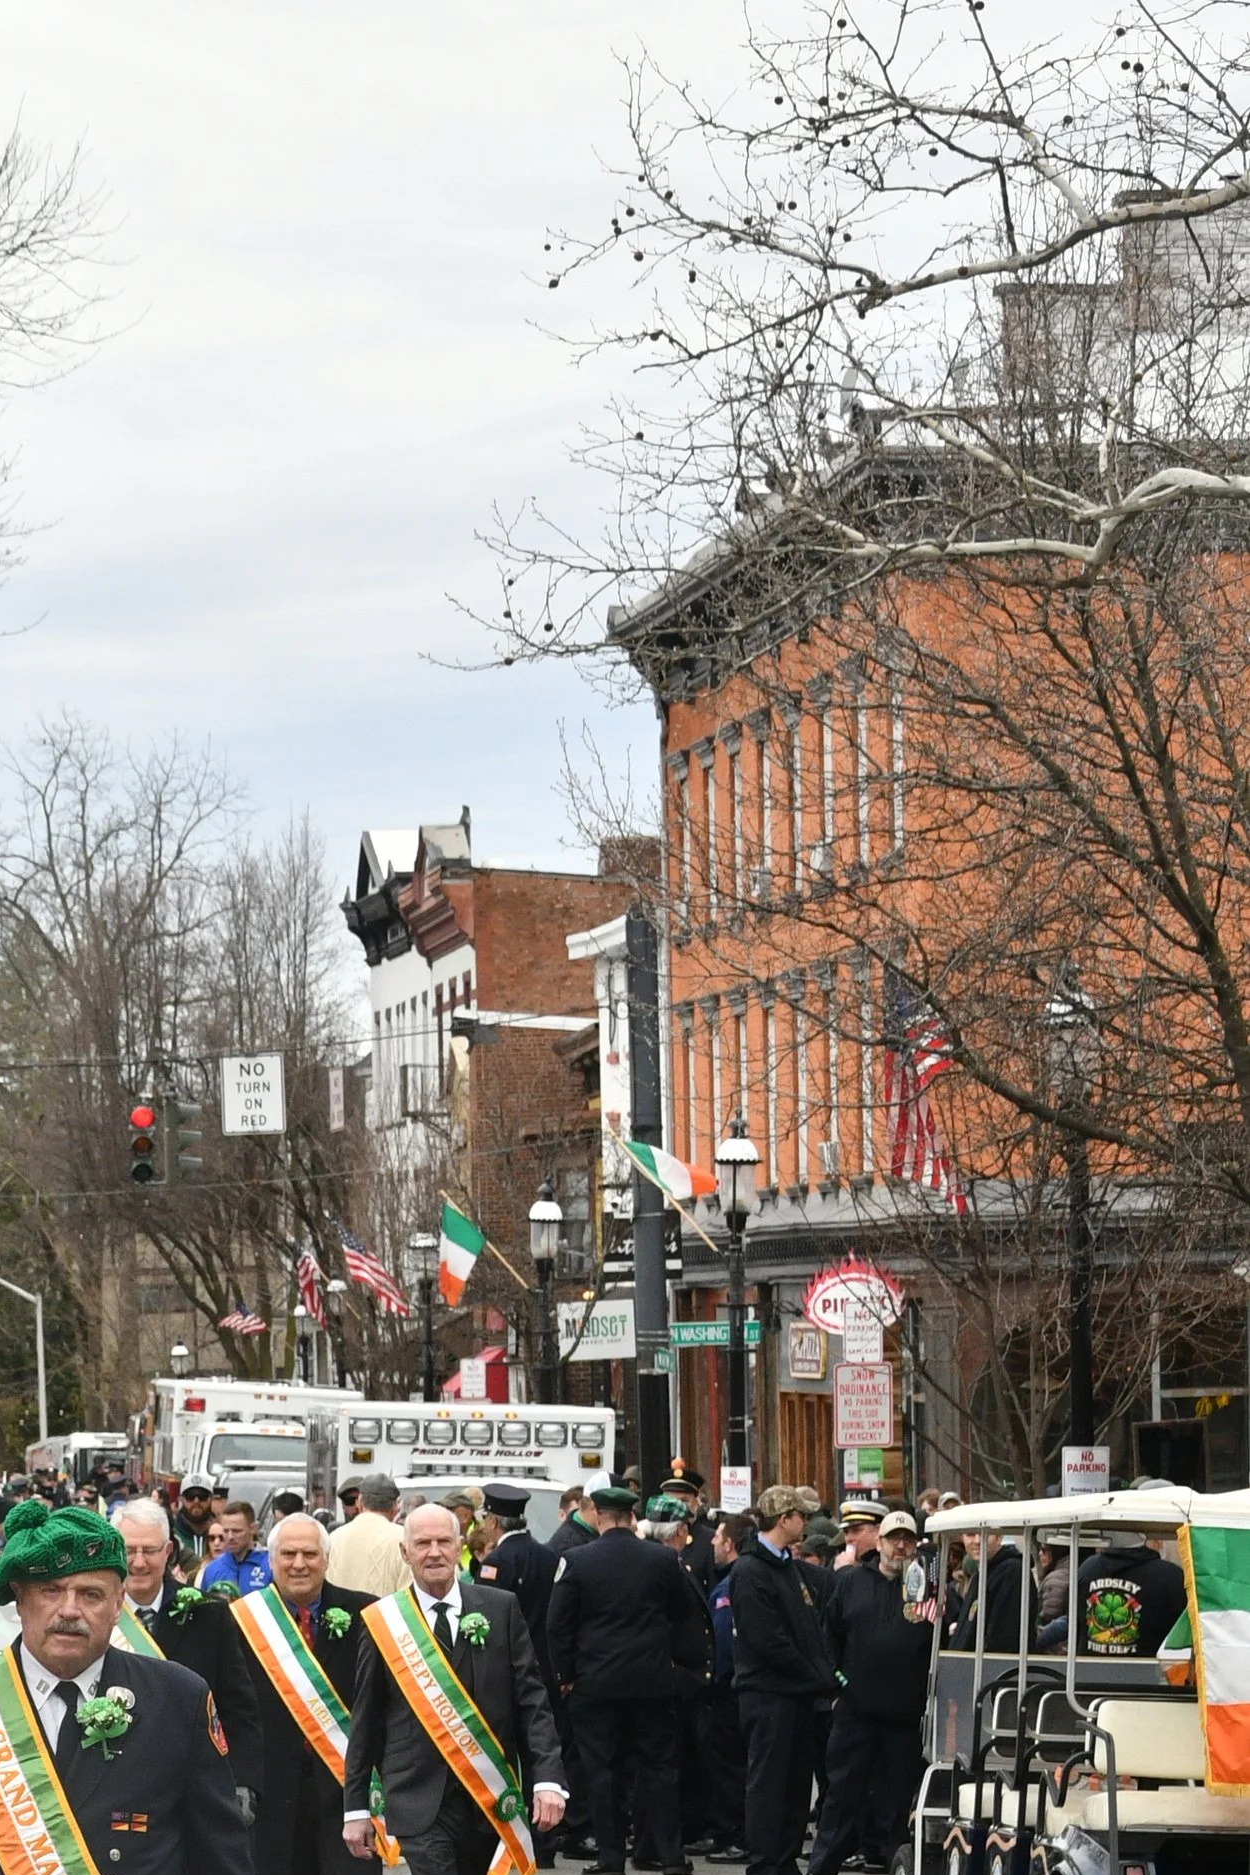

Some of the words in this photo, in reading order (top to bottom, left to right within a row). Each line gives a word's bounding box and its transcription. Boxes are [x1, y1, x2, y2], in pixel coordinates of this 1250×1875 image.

[239, 1062, 265, 1077] NO
[236, 1081, 271, 1094] TURN
[244, 1098, 262, 1110] ON
[241, 1115, 267, 1126] RED
[854, 1311, 872, 1321] NO
[750, 1330, 759, 1339] ST
[851, 1370, 875, 1381] SNOW
[839, 1384, 888, 1396] ORDINANCE
[844, 1398, 853, 1406] NO
[856, 1398, 883, 1406] PARKING
[848, 1409, 862, 1418] THIS
[865, 1408, 879, 1418] SIDE
[841, 1421, 864, 1430] DURING
[867, 1420, 886, 1429] SNOW
[844, 1431, 883, 1441] EMERGENCY
[449, 1448, 465, 1456] OF
[1081, 1451, 1094, 1462] NO
[1067, 1464, 1107, 1473] PARKING
[1089, 1577, 1142, 1594] ARDSLEY
[1087, 1641, 1107, 1653] FIRE
[397, 1632, 438, 1692] SLEEPY
[432, 1691, 483, 1757] HOLLOW
[308, 1697, 332, 1727] AIDE
